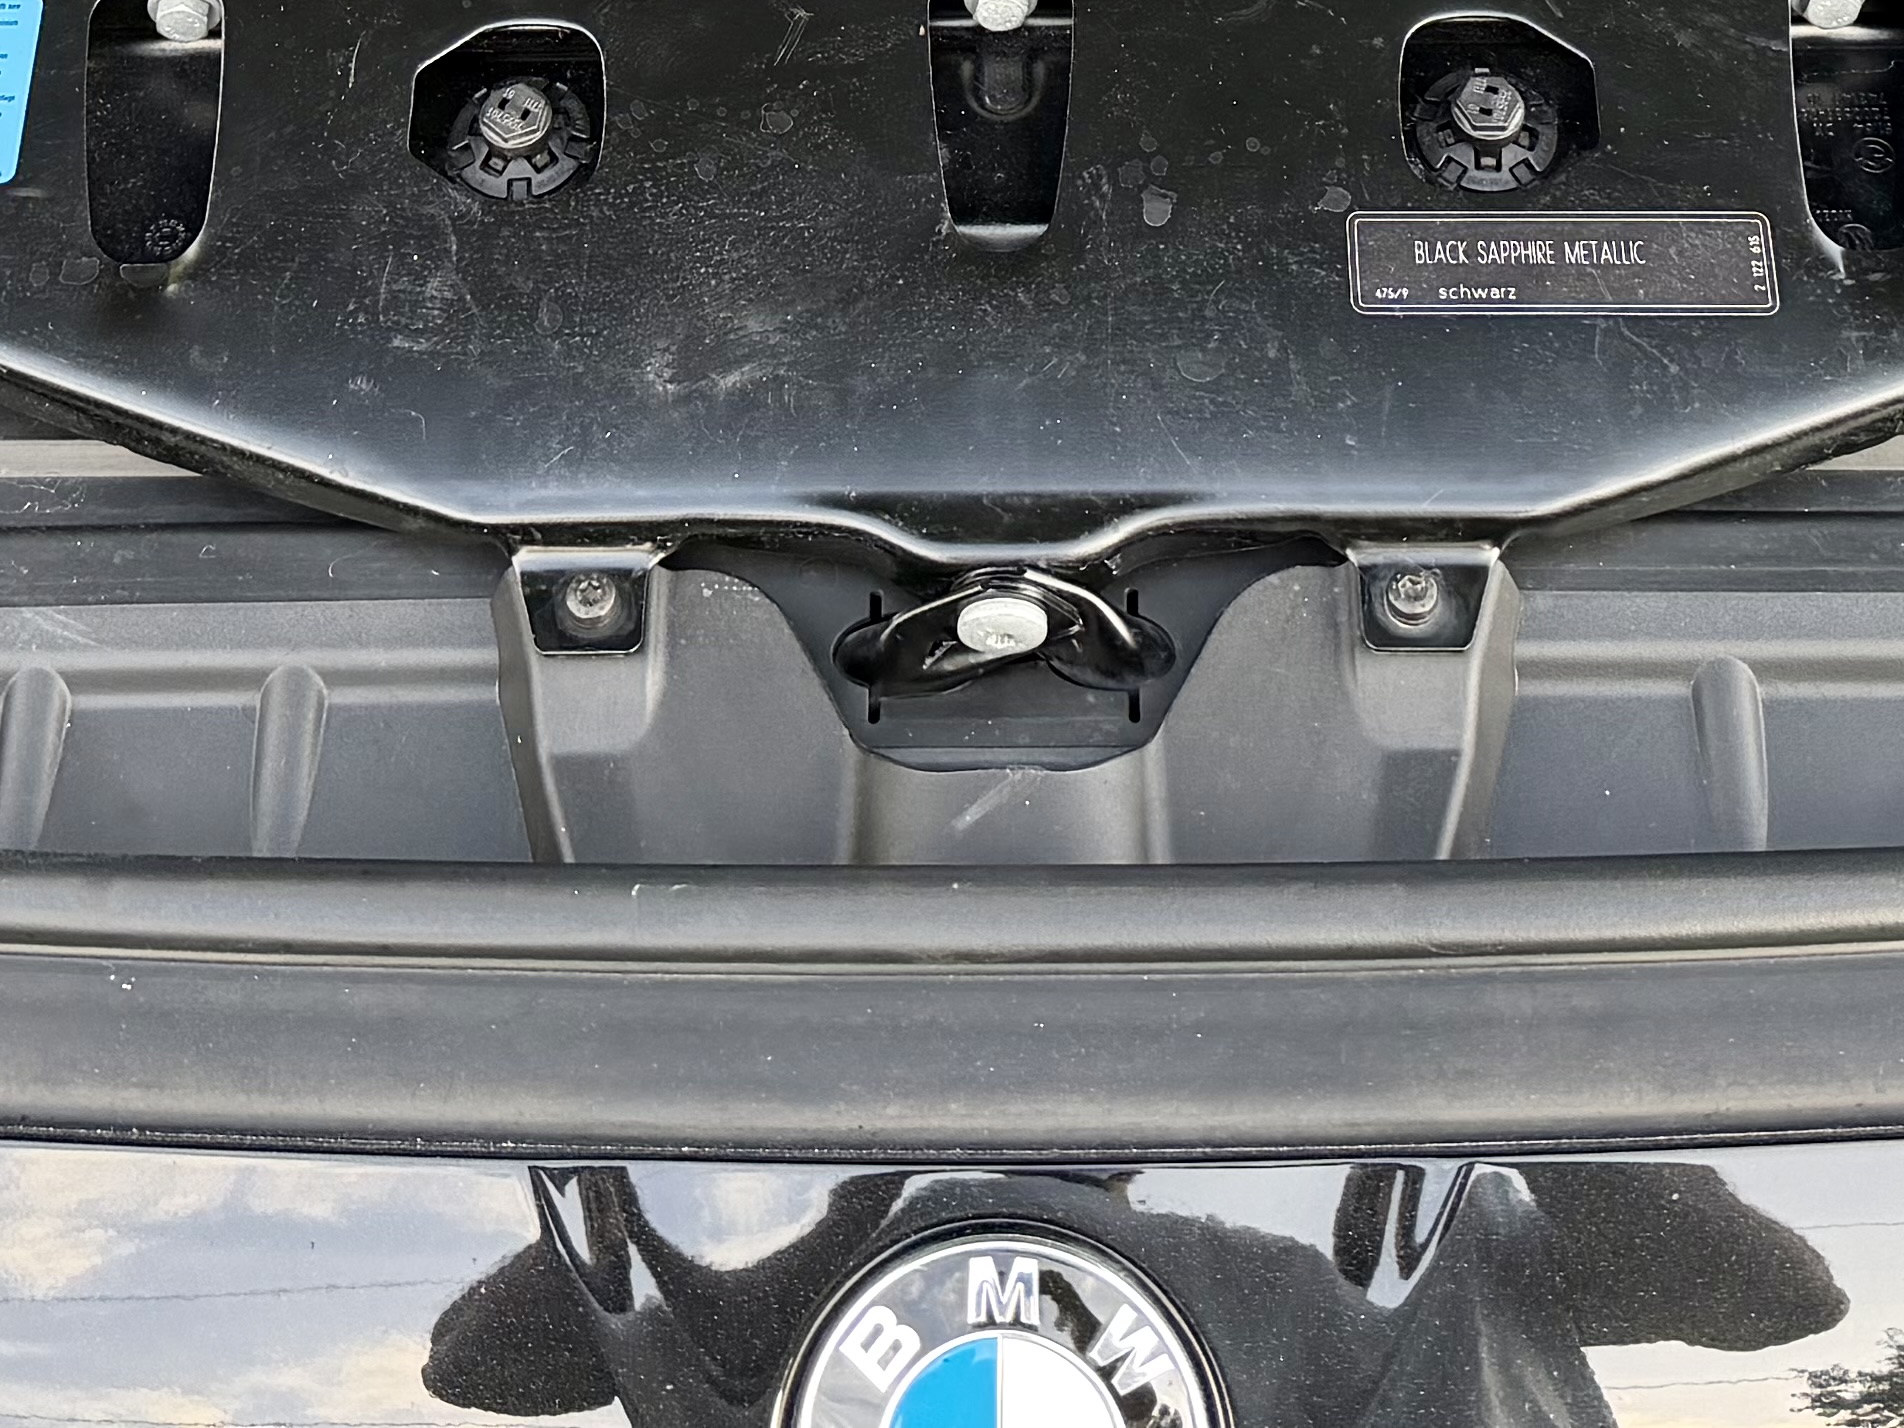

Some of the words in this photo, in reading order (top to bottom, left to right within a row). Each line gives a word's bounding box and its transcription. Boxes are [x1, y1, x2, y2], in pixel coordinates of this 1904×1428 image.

[1414, 242, 1469, 265] BLACK
[1477, 241, 1556, 264] SAPPHIRE
[1563, 241, 1647, 264] METALLIC
[1438, 286, 1517, 300] schwarz
[838, 1256, 1178, 1397] BMW
